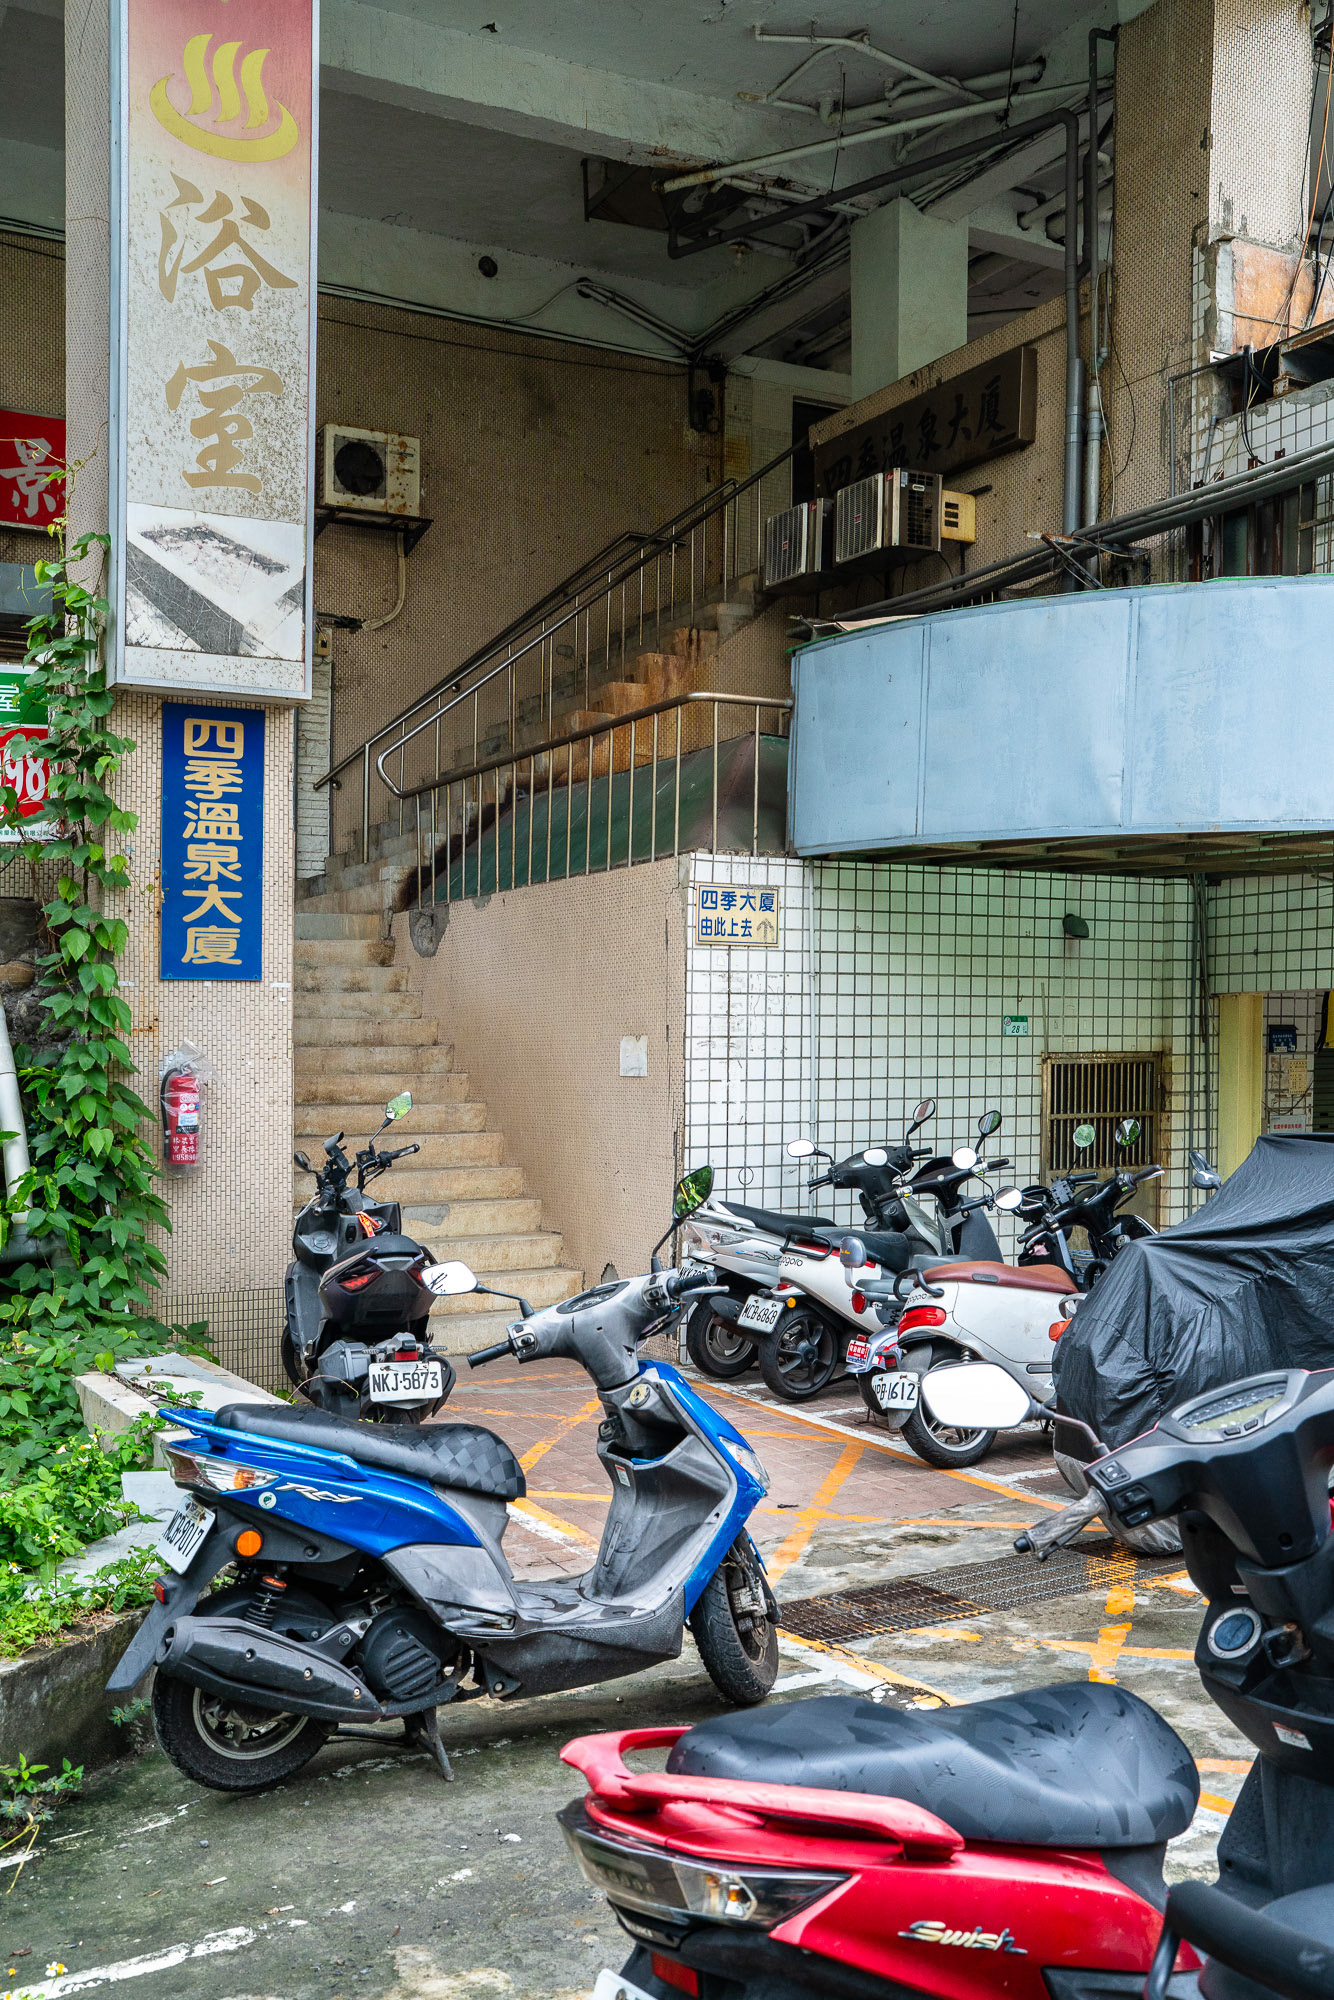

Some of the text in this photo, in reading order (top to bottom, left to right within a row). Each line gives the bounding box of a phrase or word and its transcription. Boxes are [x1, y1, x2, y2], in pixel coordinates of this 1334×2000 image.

[158, 171, 298, 494] 浴室
[0, 437, 66, 518] 景
[181, 717, 244, 965] 四季溫泉大廈
[701, 889, 775, 912] 四季大廈
[701, 916, 752, 937] 由此上去
[1011, 1025, 1021, 1034] 28
[741, 1303, 778, 1325] MCB-6868
[372, 1371, 439, 1392] NKJ-5873
[897, 1920, 1028, 1955] Swish
